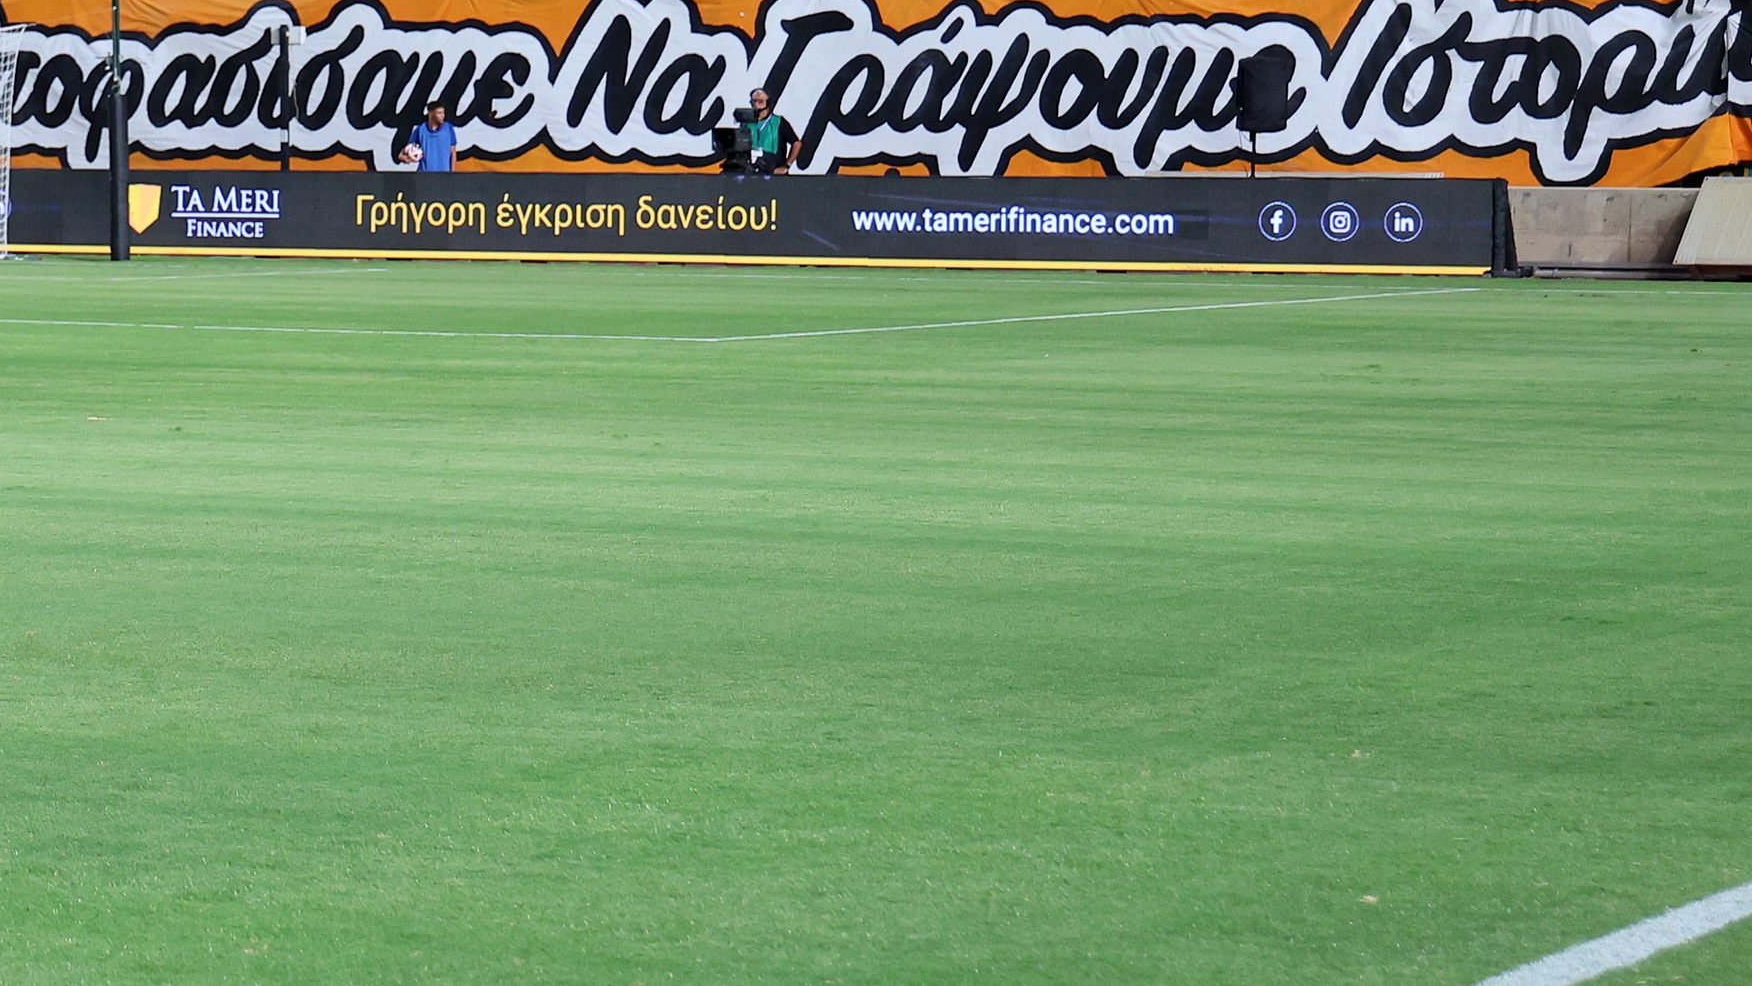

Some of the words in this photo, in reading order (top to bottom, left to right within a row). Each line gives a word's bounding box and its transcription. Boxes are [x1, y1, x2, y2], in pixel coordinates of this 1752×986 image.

[567, 13, 726, 136] Να
[171, 185, 206, 213] TA
[213, 186, 281, 213] MERI
[355, 192, 487, 236] Γρήγορη
[496, 194, 626, 237] έγκριση
[636, 195, 779, 235] δανείου!
[186, 219, 264, 238] FINANCE
[851, 205, 1175, 237] www.tamerifinance.com
